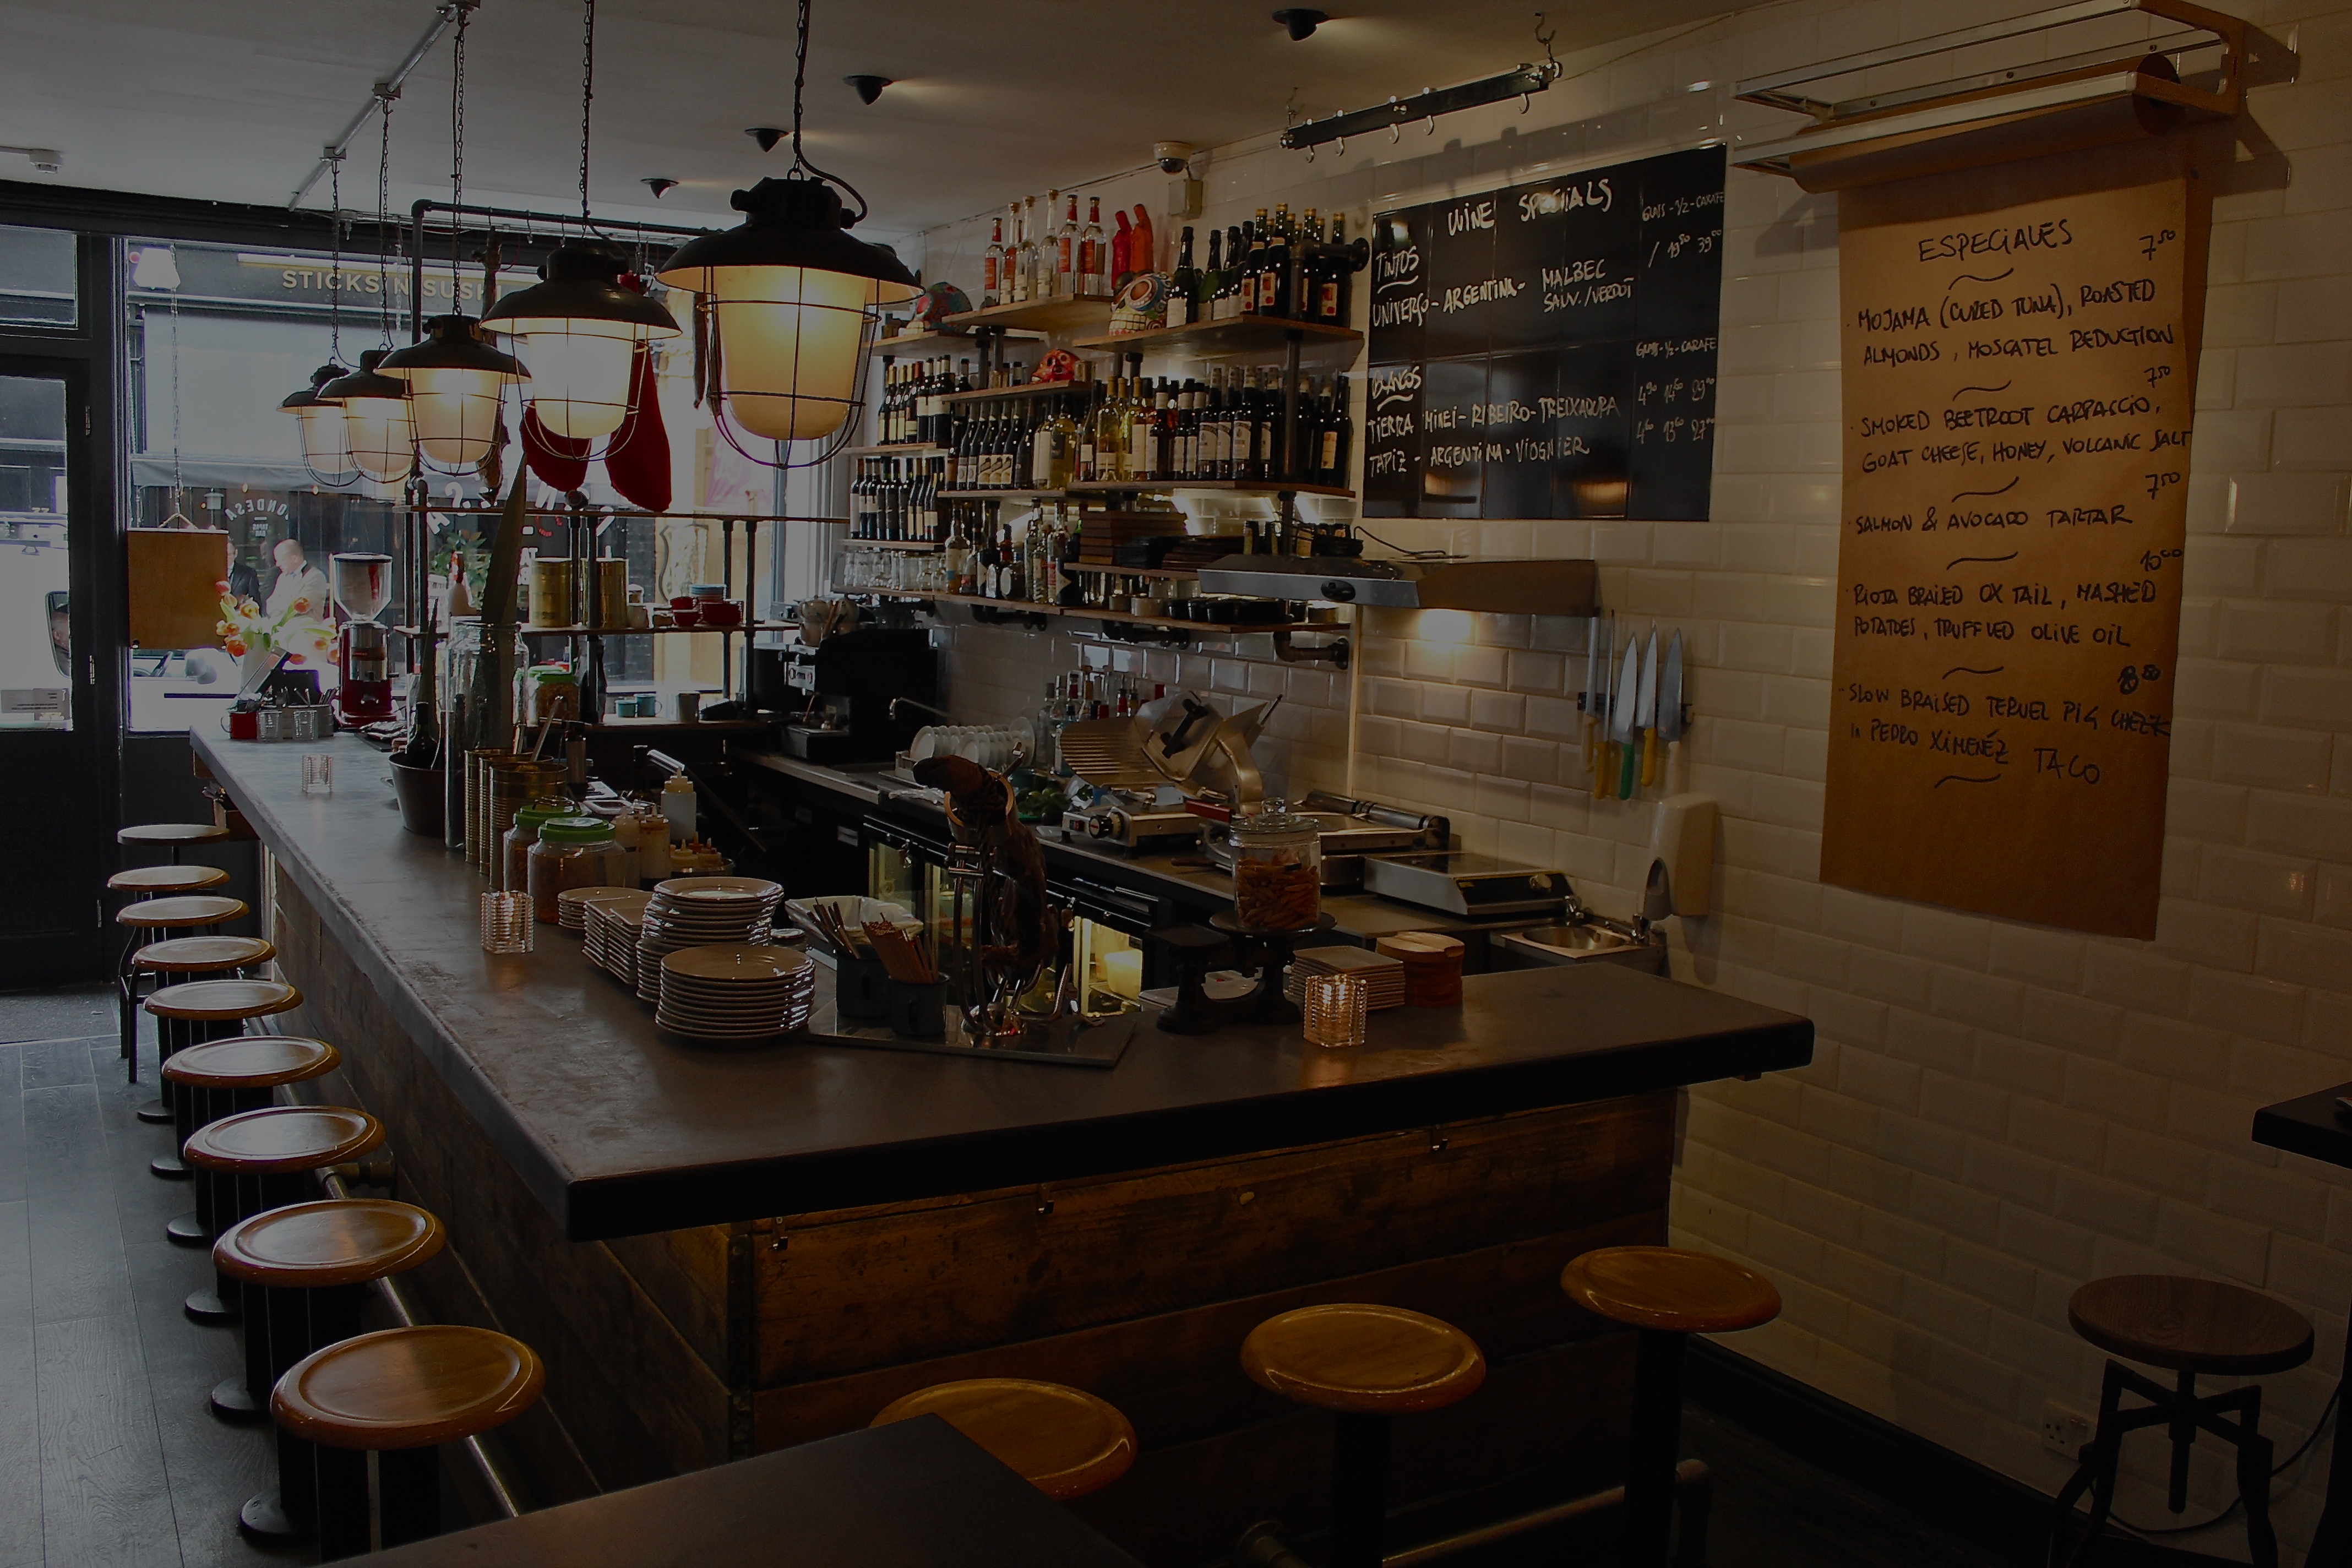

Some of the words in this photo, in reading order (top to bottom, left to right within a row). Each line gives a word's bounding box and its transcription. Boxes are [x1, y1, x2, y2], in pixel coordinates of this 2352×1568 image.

[1447, 201, 1495, 237] WINE
[1375, 245, 1420, 282] TINTOS
[1542, 258, 1607, 292] MALBEC
[282, 269, 380, 295] STICKS
[1858, 307, 1930, 331] MOJAMA
[2080, 279, 2155, 307] ROASTED
[1968, 337, 2059, 358] MOSCATEL
[2070, 324, 2174, 352] REDUCTION
[1368, 412, 1414, 444] TIERRA
[1861, 411, 1930, 438] SMOKED
[1943, 406, 2034, 431] BEETROOT
[1369, 448, 1407, 478] TAPIZ
[1515, 436, 1591, 463] VIOGNIER
[1863, 450, 1913, 472] GOAT
[2062, 433, 2141, 454] VOLCANIC
[2149, 429, 2192, 452] SALT
[1856, 514, 1912, 535] SALMON
[2047, 505, 2133, 527] TARTAR
[1979, 583, 2004, 603] OX
[2076, 580, 2156, 604] MASHED
[2030, 624, 2080, 644] OLIVE
[2092, 623, 2131, 646] OIL
[1848, 684, 1889, 703] SLOW
[2062, 701, 2099, 729] PIG
[1871, 719, 1918, 745] PEDRO
[2034, 748, 2101, 785] TACO
